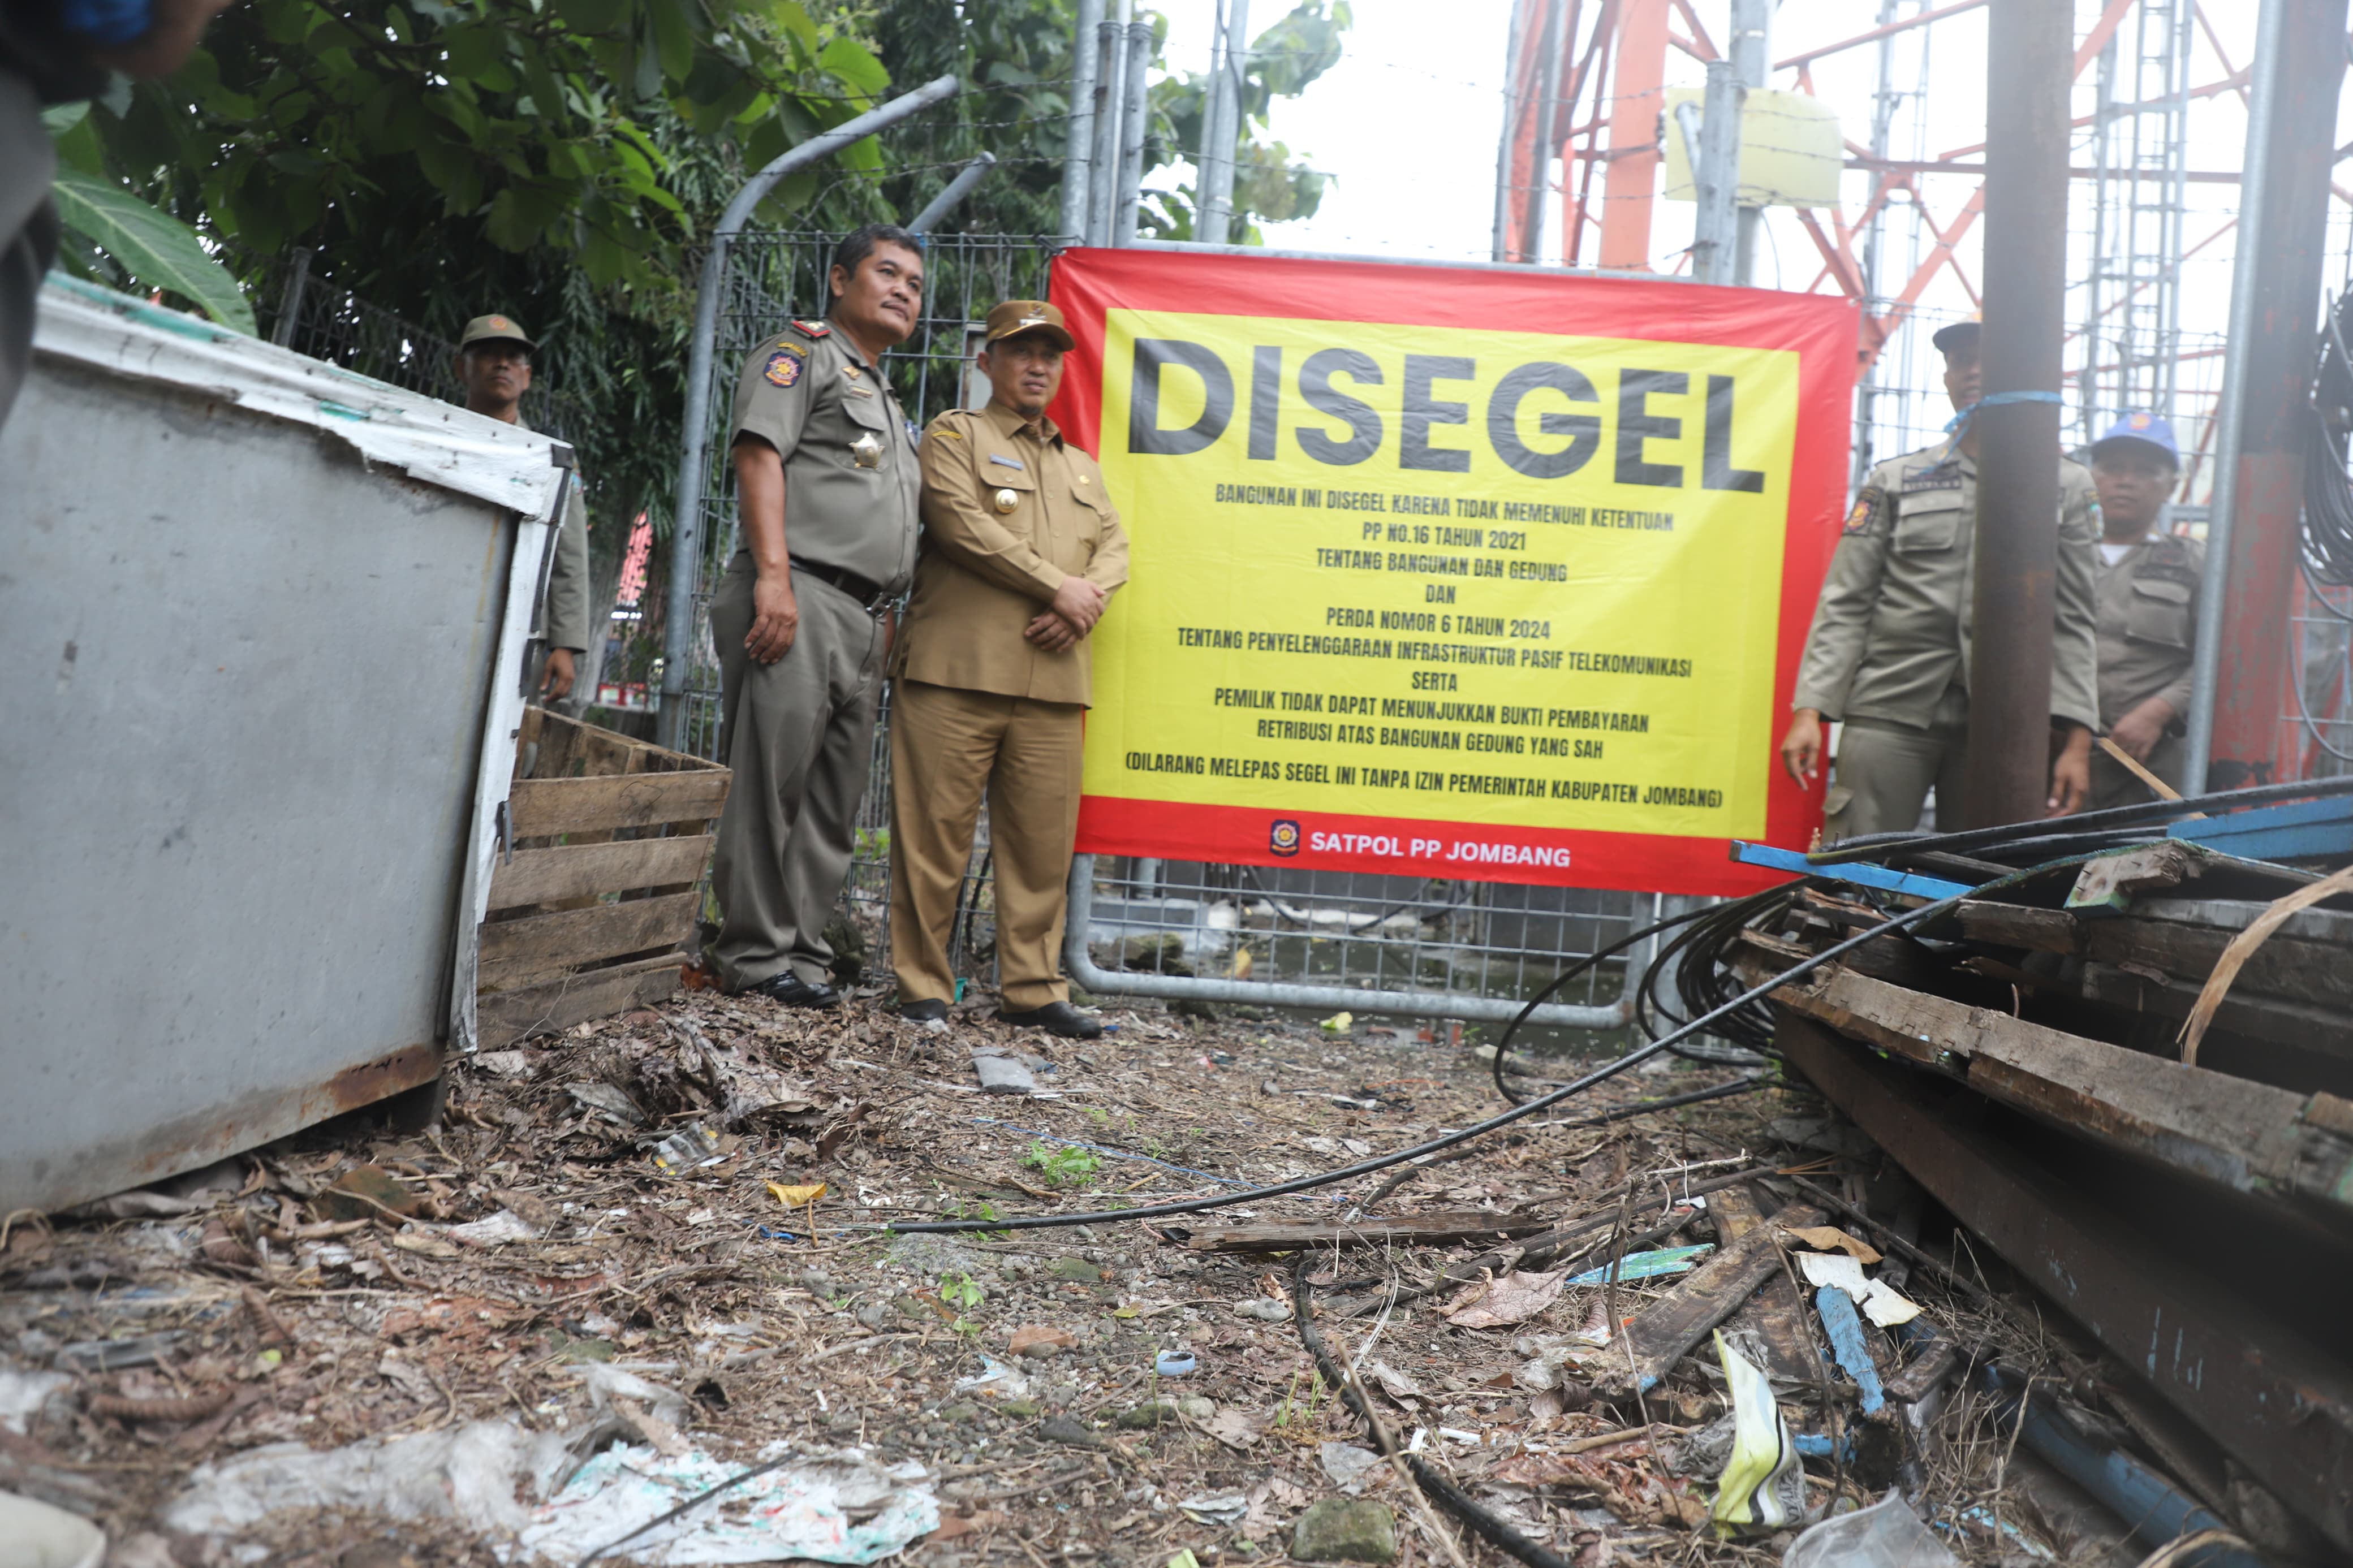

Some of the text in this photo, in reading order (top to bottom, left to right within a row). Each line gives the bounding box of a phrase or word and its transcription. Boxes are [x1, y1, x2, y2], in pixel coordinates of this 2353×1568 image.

[1128, 338, 1765, 494] DISEGEL
[1216, 484, 1674, 530] BANGUNAN INI DISEGEL KARENA TIDAK MEMENUHI KETENTUAN
[1363, 522, 1525, 550] PP NO.16 TAHUN 2021
[1317, 548, 1566, 582] TENTANG BANGUNAN DAN GEDUNG
[1426, 585, 1455, 604] DAN
[1327, 607, 1549, 639] PERDA NOMOR 6 TAHUN 2024
[1178, 628, 1691, 677] TENTANG PENYELENGGARAAN INFRASTRUKTUR PASIF TELEKOMUNIKASI
[1412, 671, 1457, 692] SERTA
[1215, 688, 1649, 733] PEMILIK TIDAK DAPAT MENUNJUKKAN BUKTI PEMBAYARAN
[1257, 719, 1603, 759] RETRIBUSI ATAS BANGUNAN GEDUNG YANG SAH
[1126, 752, 1722, 807] (DILARANG MELEPAS SEGEL INI TANPA IZIN PEMERINTAH KABUPATEN JOMBANG)
[1311, 832, 1571, 867] SATPOL PP JOMBANG
